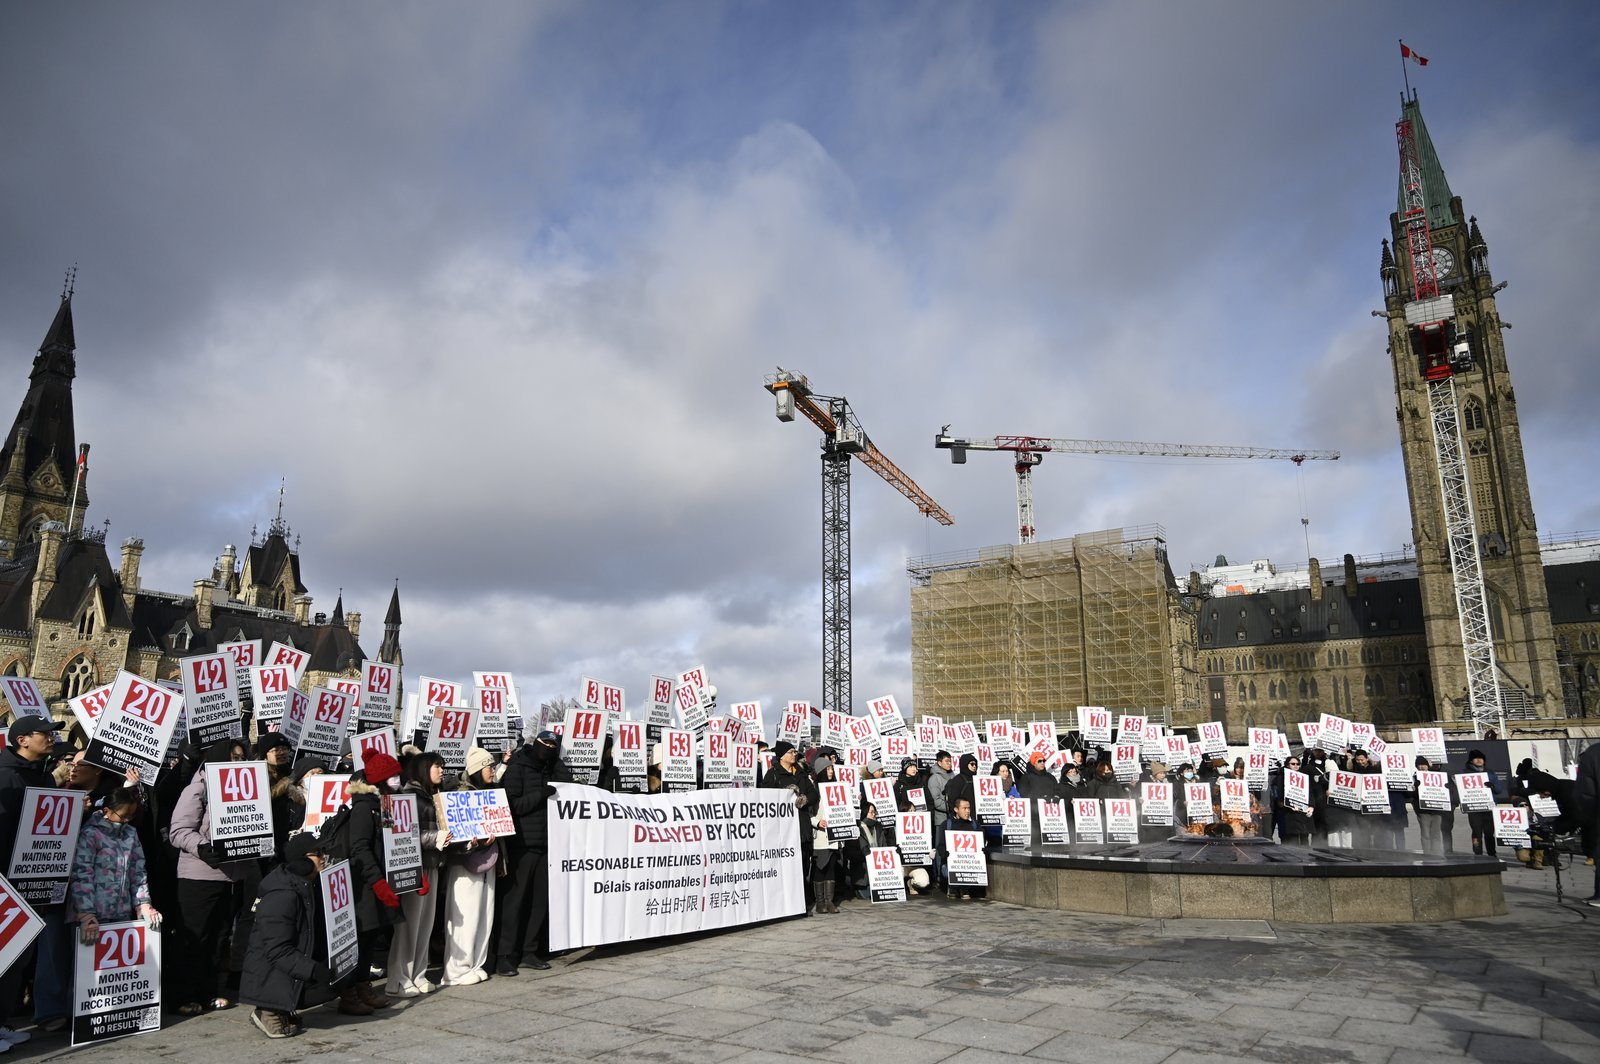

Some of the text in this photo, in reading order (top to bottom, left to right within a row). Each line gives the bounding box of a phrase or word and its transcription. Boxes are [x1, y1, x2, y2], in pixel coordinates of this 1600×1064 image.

[231, 645, 251, 666] 25
[198, 660, 224, 692] 42
[264, 668, 285, 692] 27
[371, 667, 389, 694] 42
[12, 681, 36, 705] 19
[200, 693, 225, 704] MONTHS
[430, 684, 453, 706] 22
[657, 680, 670, 702] 53
[679, 687, 695, 710] 68
[127, 683, 164, 722] 20
[195, 701, 232, 714] WAITING FOR
[484, 690, 500, 713] 31
[606, 688, 619, 711] 15
[320, 694, 343, 724] 32
[371, 711, 392, 719] RESPONSE
[739, 705, 756, 720] 20
[876, 700, 892, 716] 43
[121, 716, 154, 734] MONTHS
[192, 709, 236, 725] IRCC RESPONSE
[443, 712, 468, 738] 31
[787, 715, 800, 732] 33
[831, 713, 840, 731] 34
[1093, 714, 1106, 727] 70
[1126, 718, 1141, 731] 36
[1327, 718, 1343, 732] 38
[315, 724, 336, 733] MONTHS
[576, 714, 595, 738] 11
[854, 720, 869, 739] 30
[992, 724, 1006, 737] 27
[1205, 725, 1218, 738] 90
[1306, 726, 1319, 736] 41
[1354, 725, 1369, 734] 32
[109, 722, 159, 748] WAITING FOR
[308, 732, 327, 740] WAITING
[622, 725, 638, 748] 71
[922, 727, 933, 742] 65
[1257, 731, 1271, 743] 39
[1420, 730, 1436, 742] 33
[100, 729, 160, 758] IRCC RESPONSE
[314, 741, 340, 751] RESPONSE
[672, 734, 689, 756] 53
[712, 736, 726, 758] 34
[889, 739, 907, 754] 55
[1170, 739, 1184, 751] 37
[1371, 738, 1385, 752] 30
[738, 748, 751, 768] 68
[852, 750, 866, 765] 30
[1119, 746, 1133, 760] 31
[1251, 755, 1264, 768] 31
[1388, 755, 1405, 768] 38
[224, 768, 254, 800] 40
[841, 768, 854, 786] 33
[1291, 773, 1304, 788] 37
[1337, 774, 1355, 787] 37
[1364, 776, 1381, 790] 37
[1424, 774, 1441, 786] 40
[1464, 776, 1483, 789] 31
[872, 783, 888, 798] 24
[982, 779, 997, 795] 34
[1149, 786, 1166, 800] 14
[1191, 787, 1205, 800] 37
[1228, 782, 1242, 796] 37
[447, 791, 496, 807] STOP THE
[829, 786, 846, 806] 41
[35, 796, 69, 834] 20
[227, 804, 256, 814] MONTHS
[392, 800, 410, 832] 40
[557, 800, 795, 823] WE DEMAND A TIMELY DECISION
[1010, 801, 1024, 817] 35
[1081, 802, 1095, 816] 36
[1114, 802, 1129, 816] 21
[1502, 810, 1520, 823] 22
[220, 813, 264, 825] WAITING FOR
[905, 817, 923, 833] 40
[217, 823, 269, 835] IRCC RESPONSE
[634, 823, 756, 842] DELAYED BY IRCC
[32, 841, 62, 849] MONTHS
[956, 834, 975, 852] 22
[22, 852, 66, 861] WAITING FOR
[561, 847, 795, 872] REASONABLE TIMELINES PROCEDURAL FAIRNESS
[875, 851, 894, 869] 43
[14, 864, 68, 874] IRCC RESPONSE
[594, 868, 778, 894] Délais raisonnables Équité procédurale
[331, 869, 348, 910] 36
[646, 889, 750, 917] 给出时限 程序公平
[100, 928, 141, 968] 20
[99, 970, 139, 984] MONTHS
[88, 980, 149, 997] WAITING FOR
[81, 991, 154, 1011] IRCC RESPONSE
[90, 1016, 102, 1026] NO
[94, 1020, 140, 1035] NO RESULTS
